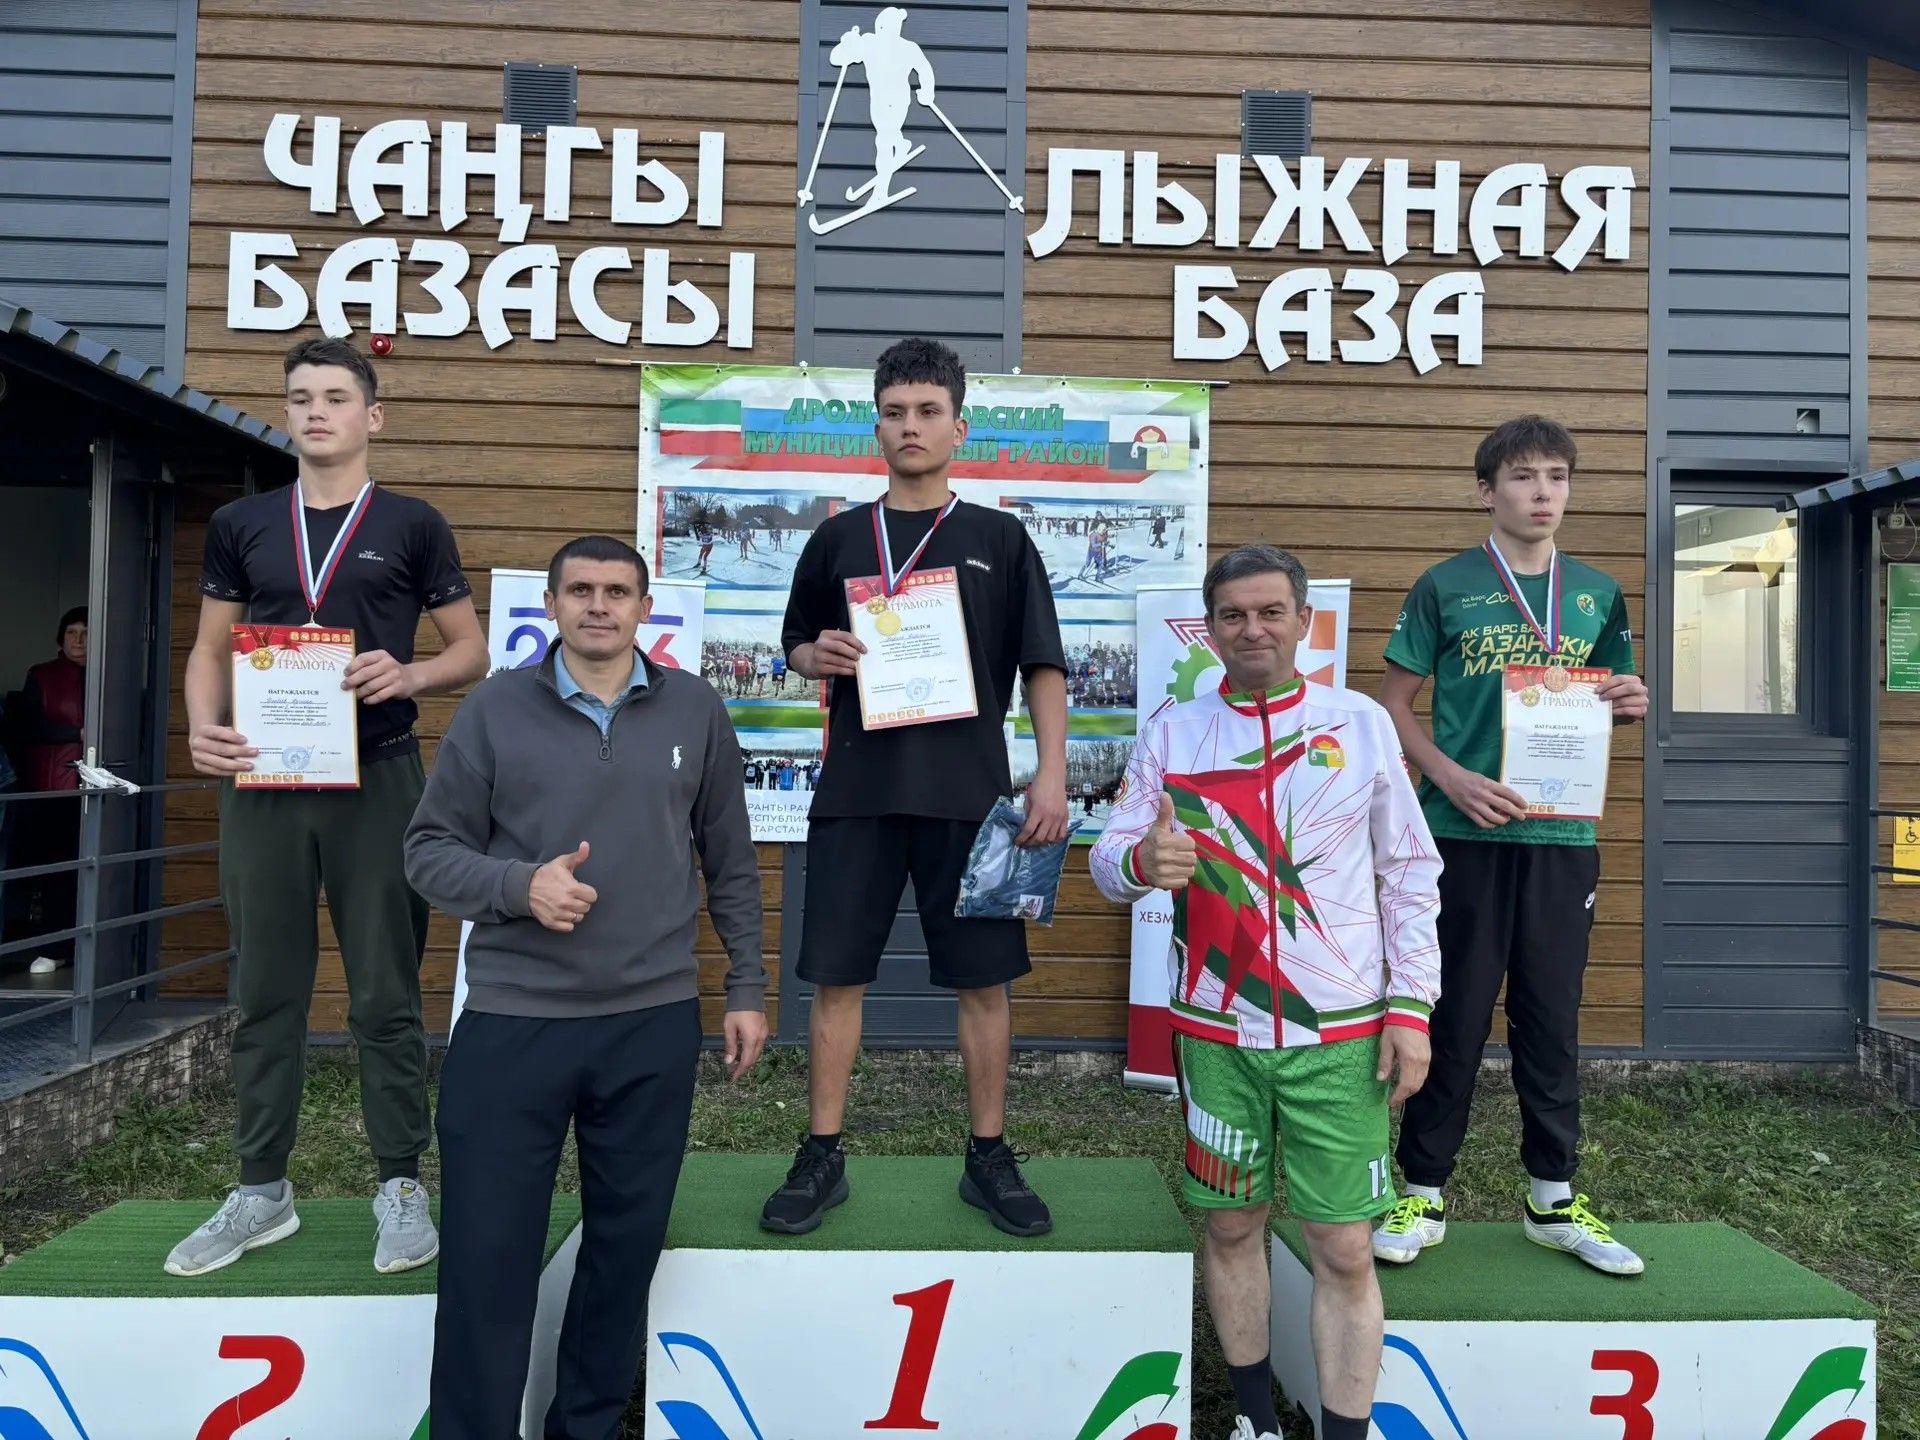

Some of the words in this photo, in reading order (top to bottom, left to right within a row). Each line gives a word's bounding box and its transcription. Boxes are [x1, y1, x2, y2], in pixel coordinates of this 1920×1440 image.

[263, 113, 725, 243] ЧАҢГЫ
[1027, 147, 1636, 273] ЛЫЖНАЯ
[227, 231, 756, 350] БАЗАСЫ
[1173, 265, 1486, 376] БАЗА
[1008, 437, 1106, 465] РАЙОН
[278, 658, 336, 671] ГРАМОТА
[1461, 627, 1479, 641] АК
[1483, 624, 1518, 636] БАРС
[1543, 696, 1593, 709] ГРАМОТА
[748, 803, 787, 812] РАНТЫ
[194, 1335, 305, 1440] 2
[863, 1279, 954, 1430] 1
[1589, 1350, 1659, 1440] 3
